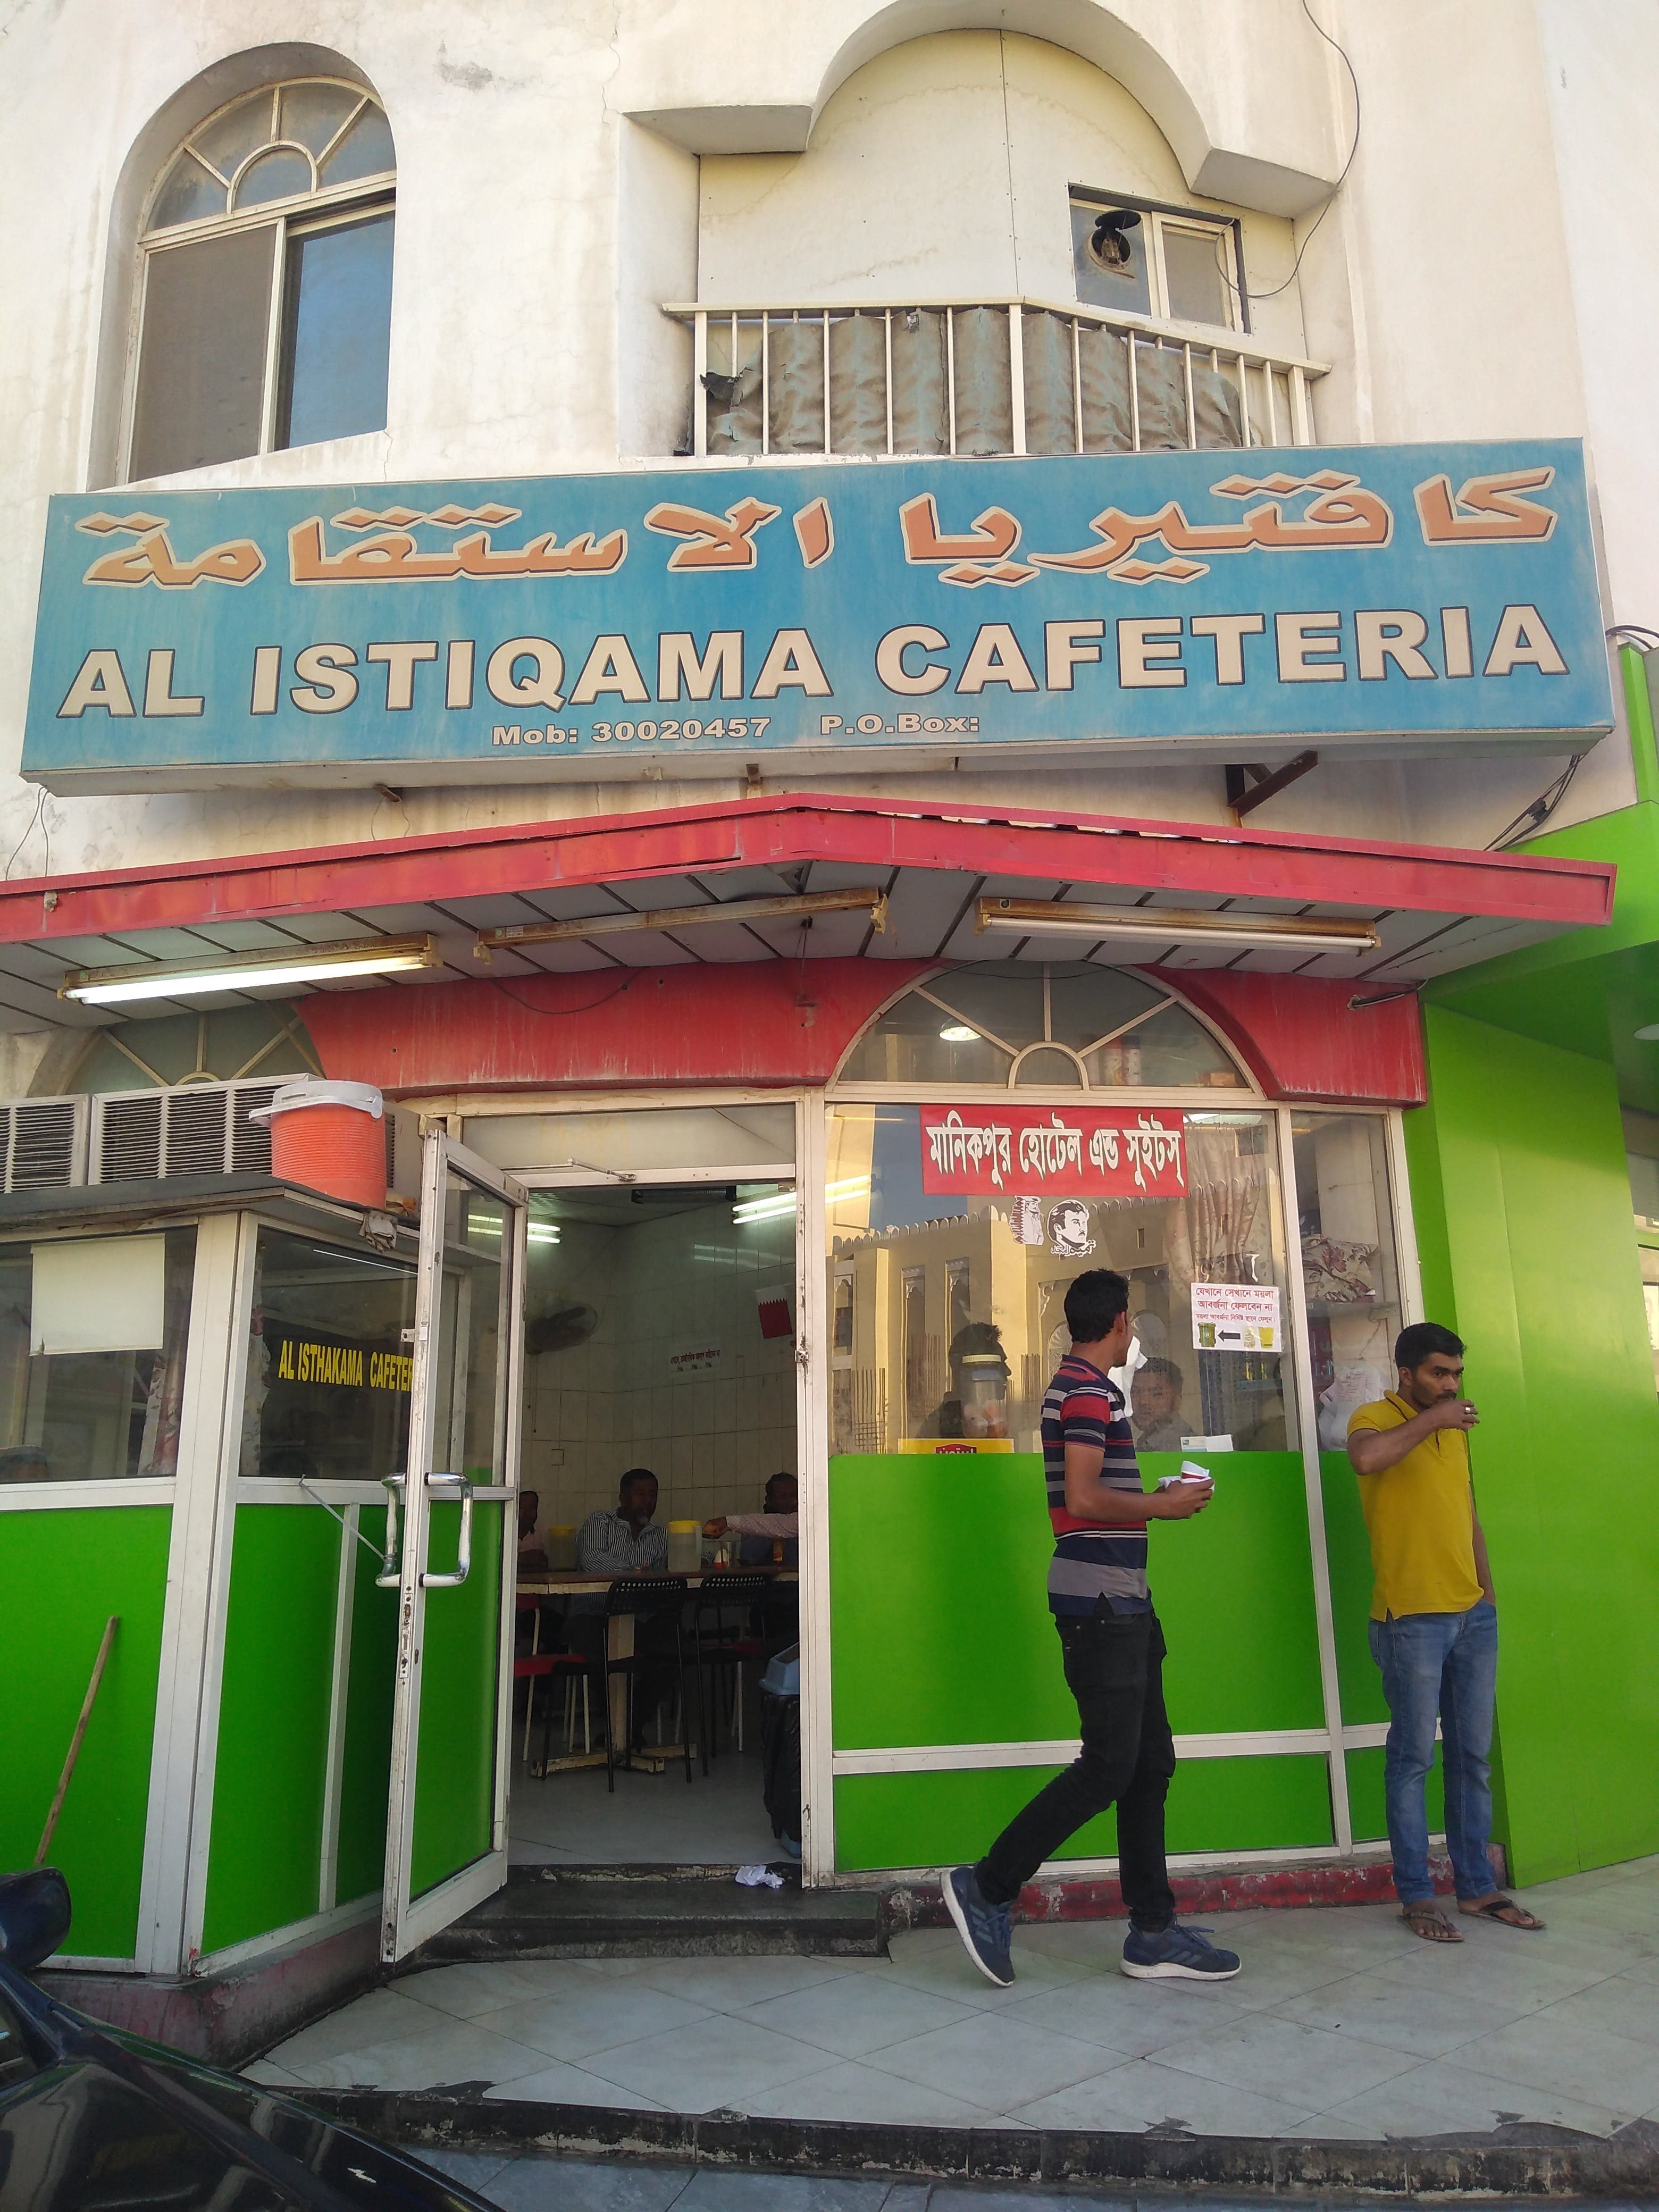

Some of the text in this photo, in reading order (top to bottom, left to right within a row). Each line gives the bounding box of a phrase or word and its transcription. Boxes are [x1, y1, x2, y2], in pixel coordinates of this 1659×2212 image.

[74, 466, 1559, 590] كافتيريا الاستقامة
[56, 604, 1569, 718] AL ISTIQAMA CAFETERIA
[492, 717, 771, 745] Mob: 30020457
[820, 713, 979, 735] P.O.Box:
[925, 1109, 1013, 1192] মানিকপুর
[1019, 1111, 1084, 1181] হোটেল
[1121, 1113, 1185, 1193] সুইটস্
[1196, 1287, 1222, 1296] যেখানে
[1225, 1288, 1251, 1297] সেখানে
[1197, 1298, 1273, 1312] আবর্জনা ফেলবেন না
[278, 1339, 295, 1380] AL
[297, 1342, 363, 1387] ISTHAKAMA
